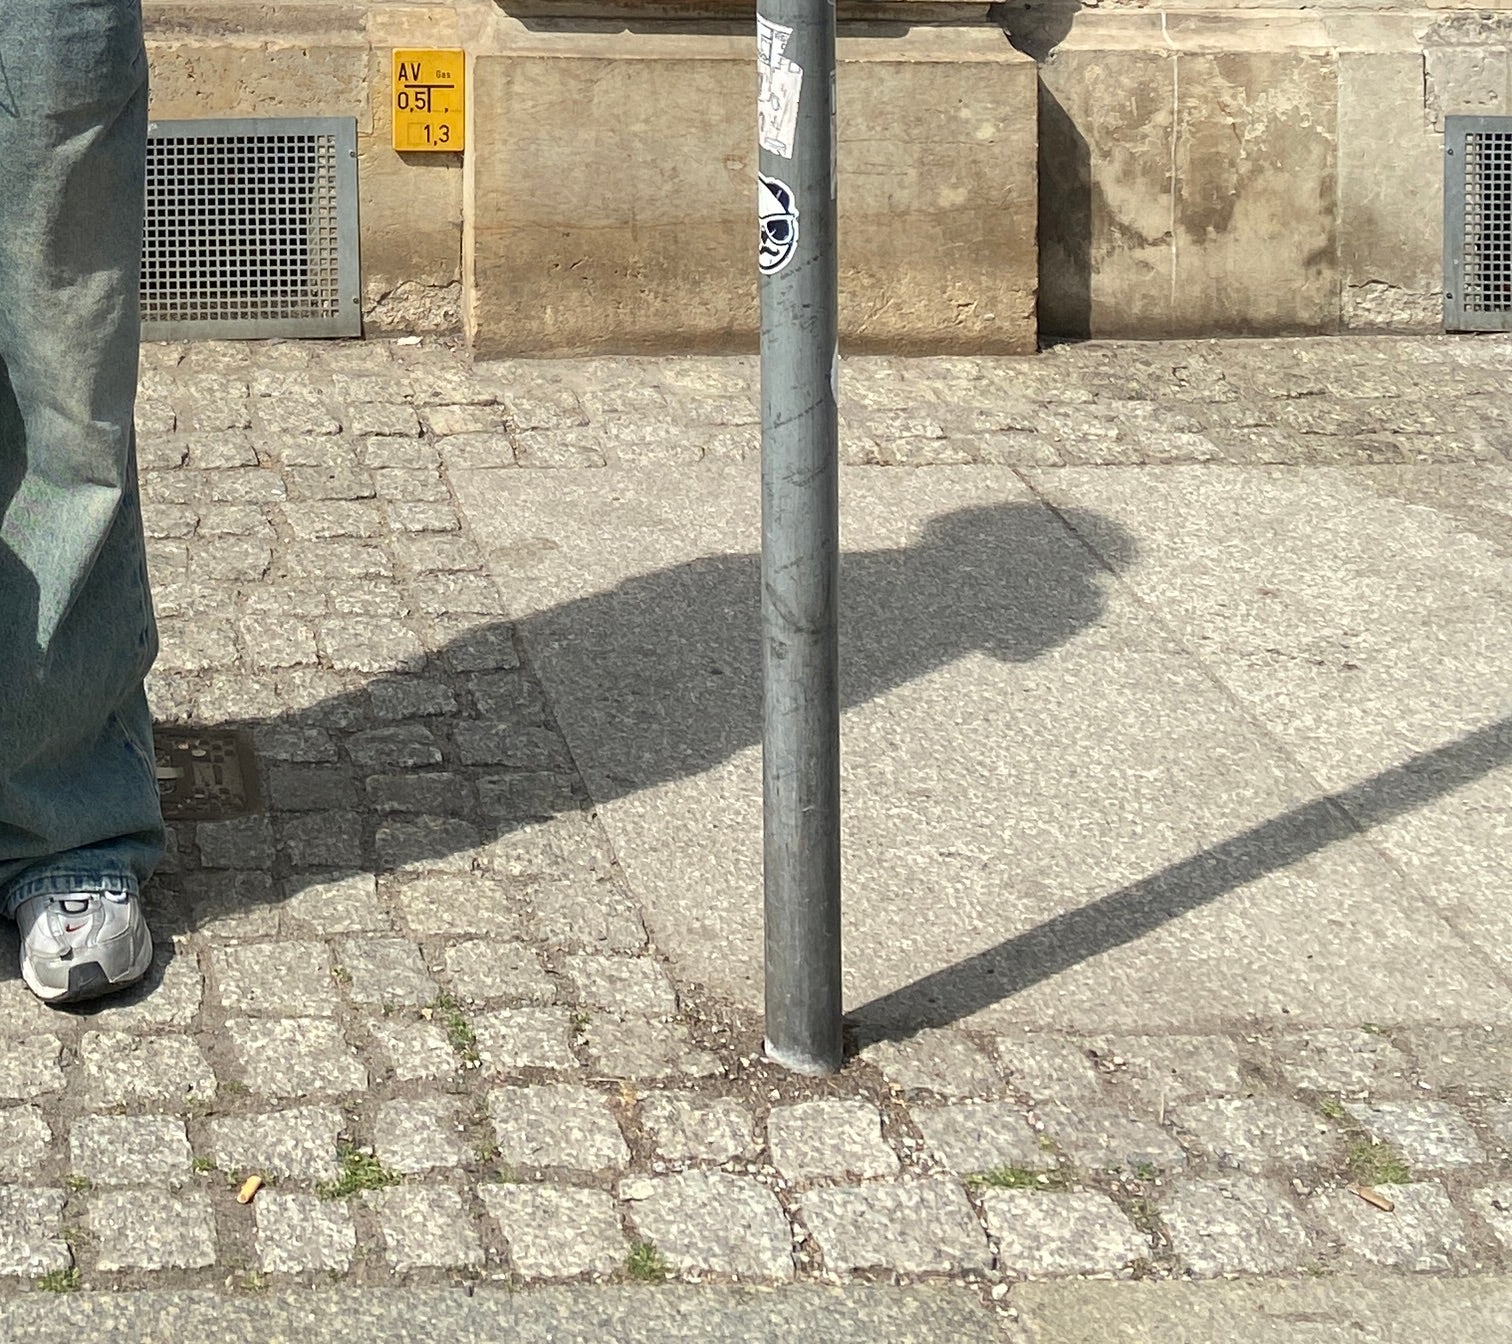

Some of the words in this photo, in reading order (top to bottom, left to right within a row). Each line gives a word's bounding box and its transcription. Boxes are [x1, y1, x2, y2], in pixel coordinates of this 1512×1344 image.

[398, 62, 421, 82] AV
[436, 70, 451, 79] Gas
[397, 91, 426, 112] 0,5
[424, 124, 450, 146] 1,3
